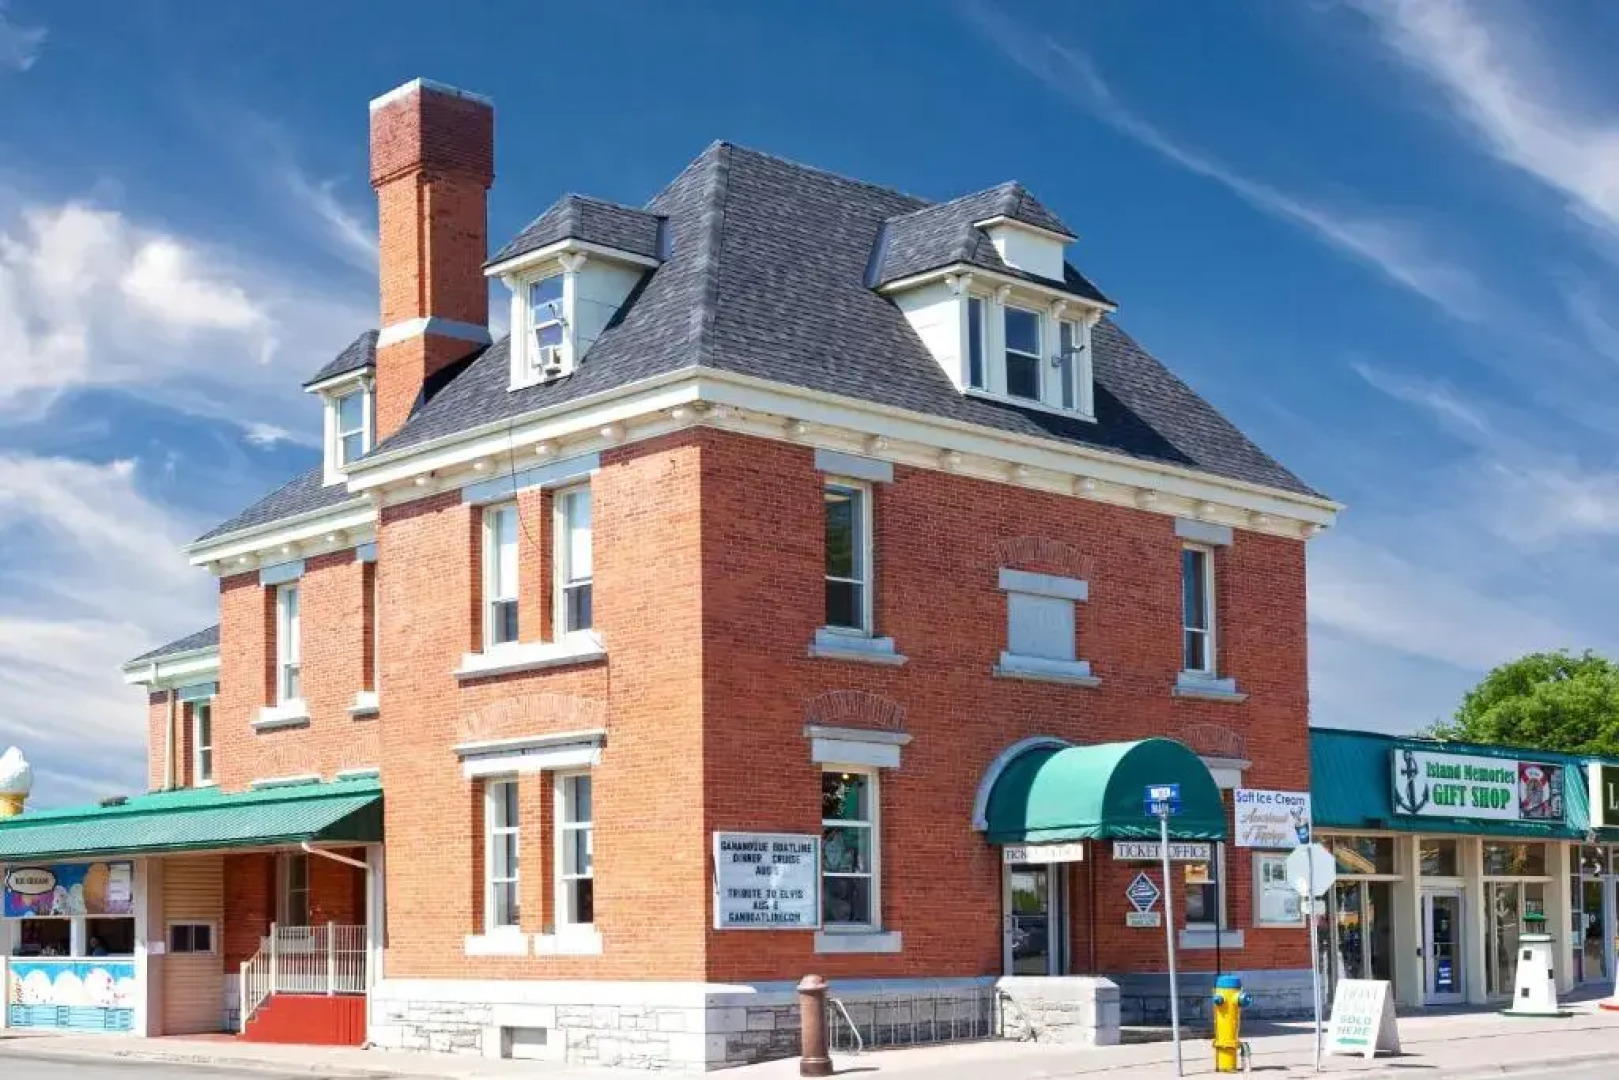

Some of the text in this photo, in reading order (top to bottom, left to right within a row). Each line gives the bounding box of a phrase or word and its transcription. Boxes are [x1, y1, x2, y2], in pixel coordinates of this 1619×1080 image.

[1426, 762, 1461, 779] Island
[1464, 764, 1515, 784] Memories
[1236, 791, 1304, 806] Soft Ice Cream
[1433, 784, 1510, 809] GIFT SHOP
[772, 842, 812, 853] BOATLINE
[1117, 844, 1208, 858] TICKET OFFICE
[733, 854, 801, 864] DINNER CRUISE
[728, 889, 804, 899] TRIBUTE TO ELVIS
